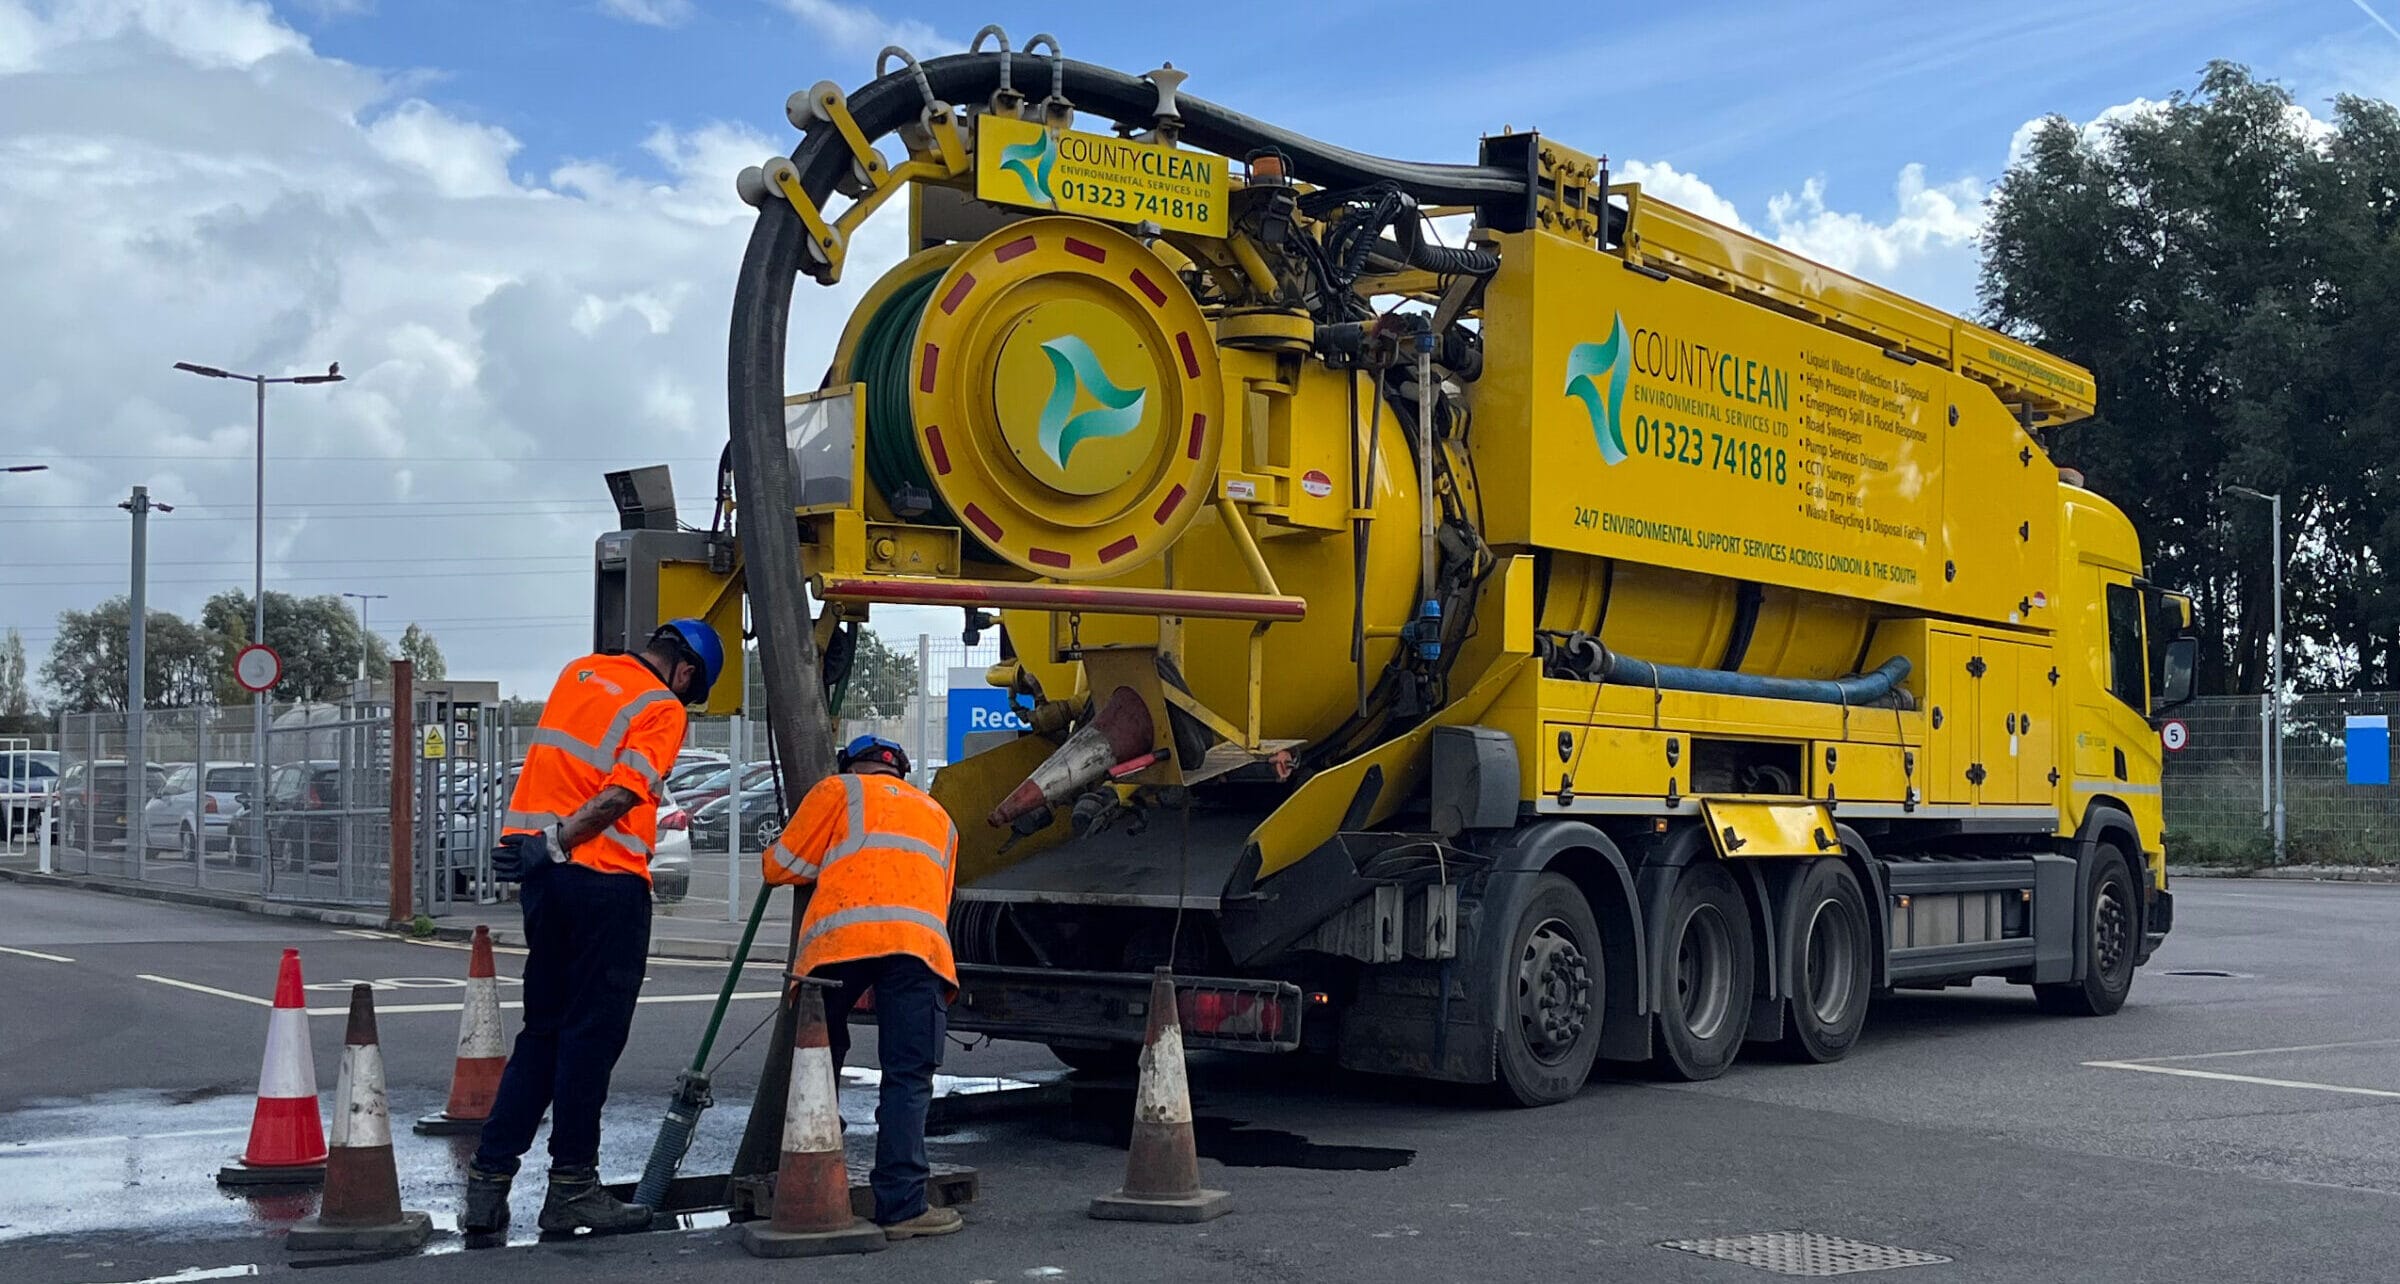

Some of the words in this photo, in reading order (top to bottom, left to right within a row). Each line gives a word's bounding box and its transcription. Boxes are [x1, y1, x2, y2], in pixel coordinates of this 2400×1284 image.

[1059, 136, 1211, 185] COUNTYCLEAN
[1060, 165, 1143, 188] ENVIRONMENTAL
[1148, 179, 1191, 196] SERVICES
[1194, 188, 1211, 199] LTD
[1061, 180, 1126, 208] 01323
[1133, 192, 1209, 222] 741818
[1633, 328, 1788, 412] COUNTYCLEAN
[1806, 350, 1830, 371] Liquid
[1831, 359, 1855, 378] Waste
[1856, 368, 1892, 389] Collection
[1893, 379, 1899, 393] &
[1900, 382, 1929, 403] Disposal
[1806, 372, 1824, 393] High
[1825, 378, 1857, 400] Pressure
[1859, 388, 1880, 408] Water
[1634, 384, 1722, 422] ENVIRONMENTAL
[1725, 408, 1770, 434] SERVICES
[1773, 420, 1789, 438] LTD
[1805, 415, 1825, 435] Road
[1827, 422, 1862, 444] Sweepers
[1806, 394, 1847, 422] Emergency
[1849, 407, 1864, 425] Spill
[1866, 412, 1872, 426] &
[1873, 415, 1894, 433] Flood
[1895, 419, 1927, 443] Response
[1635, 415, 1703, 466] 01323
[1711, 433, 1787, 485] 741818
[1805, 438, 1827, 459] Pump
[1829, 444, 1858, 464] Services
[1860, 453, 1888, 472] Division
[1805, 460, 1825, 477] CCTV
[1827, 465, 1855, 487] Surveys
[1806, 482, 1824, 498] Grab
[1825, 486, 1845, 507] Lorry
[1846, 493, 1863, 508] Hire
[1806, 504, 1828, 522] Waste
[1829, 509, 1864, 533] Recycling
[1866, 517, 1871, 531] &
[1873, 518, 1902, 537] Disposal
[1904, 525, 1927, 545] Facility
[1574, 507, 1599, 530] 24/7
[1602, 512, 1694, 547] ENVIRONMENTAL
[1697, 530, 1741, 554] SUPPORT
[1744, 539, 1786, 562] SERVICES
[1789, 548, 1823, 569] ACROSS
[1826, 555, 1861, 575] LONDON
[1864, 560, 1870, 577] &
[1873, 562, 1888, 580] THE
[1890, 565, 1916, 585] SOUTH
[457, 725, 465, 736] 5
[2170, 729, 2179, 742] 5
